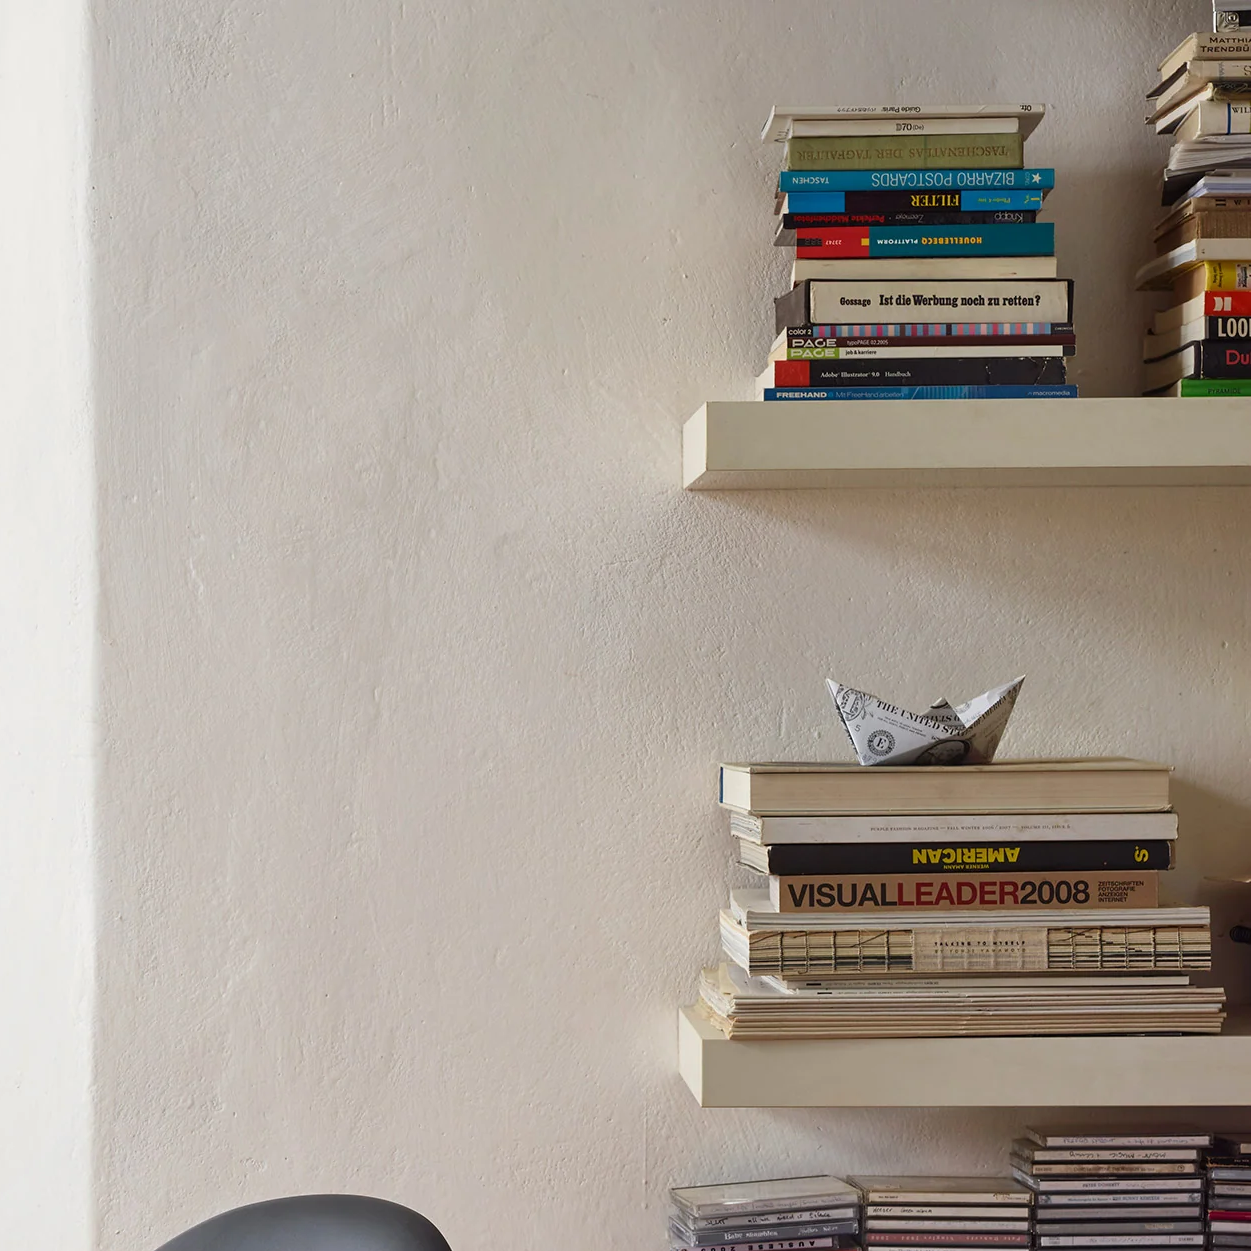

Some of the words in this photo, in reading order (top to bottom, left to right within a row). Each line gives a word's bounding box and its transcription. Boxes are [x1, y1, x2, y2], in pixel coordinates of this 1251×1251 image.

[797, 150, 872, 162] TAGFALTER
[876, 148, 902, 159] DER
[909, 146, 1008, 159] TASCHENATLAS
[792, 176, 830, 185] TASCHEN
[871, 173, 952, 187] POSTCARDS
[957, 172, 1015, 187] BIZARRO
[910, 194, 960, 207] FILTER
[793, 215, 850, 224] Mädchenfotos
[851, 214, 885, 223] Perfekte
[994, 212, 1024, 223] Knapp
[921, 236, 982, 245] HOUELLEBECQ
[840, 297, 871, 308] Gossage
[879, 295, 893, 306] Ist
[895, 295, 911, 306] die
[912, 295, 958, 309] Werbung
[960, 295, 986, 306] noch
[987, 298, 1001, 306] zu
[1002, 295, 1041, 306] retten?
[788, 328, 806, 336] color
[1218, 318, 1251, 338] LOO
[792, 338, 837, 348] PAGE
[790, 348, 836, 358] PAGE
[1226, 350, 1251, 365] Du
[884, 370, 911, 378] Handbuch
[835, 390, 846, 398] Mit
[876, 390, 904, 398] arbeiten
[1032, 389, 1070, 397] macromedia
[876, 699, 898, 715] THE
[900, 709, 940, 731] UNITED
[876, 737, 888, 749] E
[912, 847, 1021, 863] AMERICAN
[788, 881, 1090, 907] VISUALLEADER2008
[748, 1240, 815, 1251] AUSLESE
